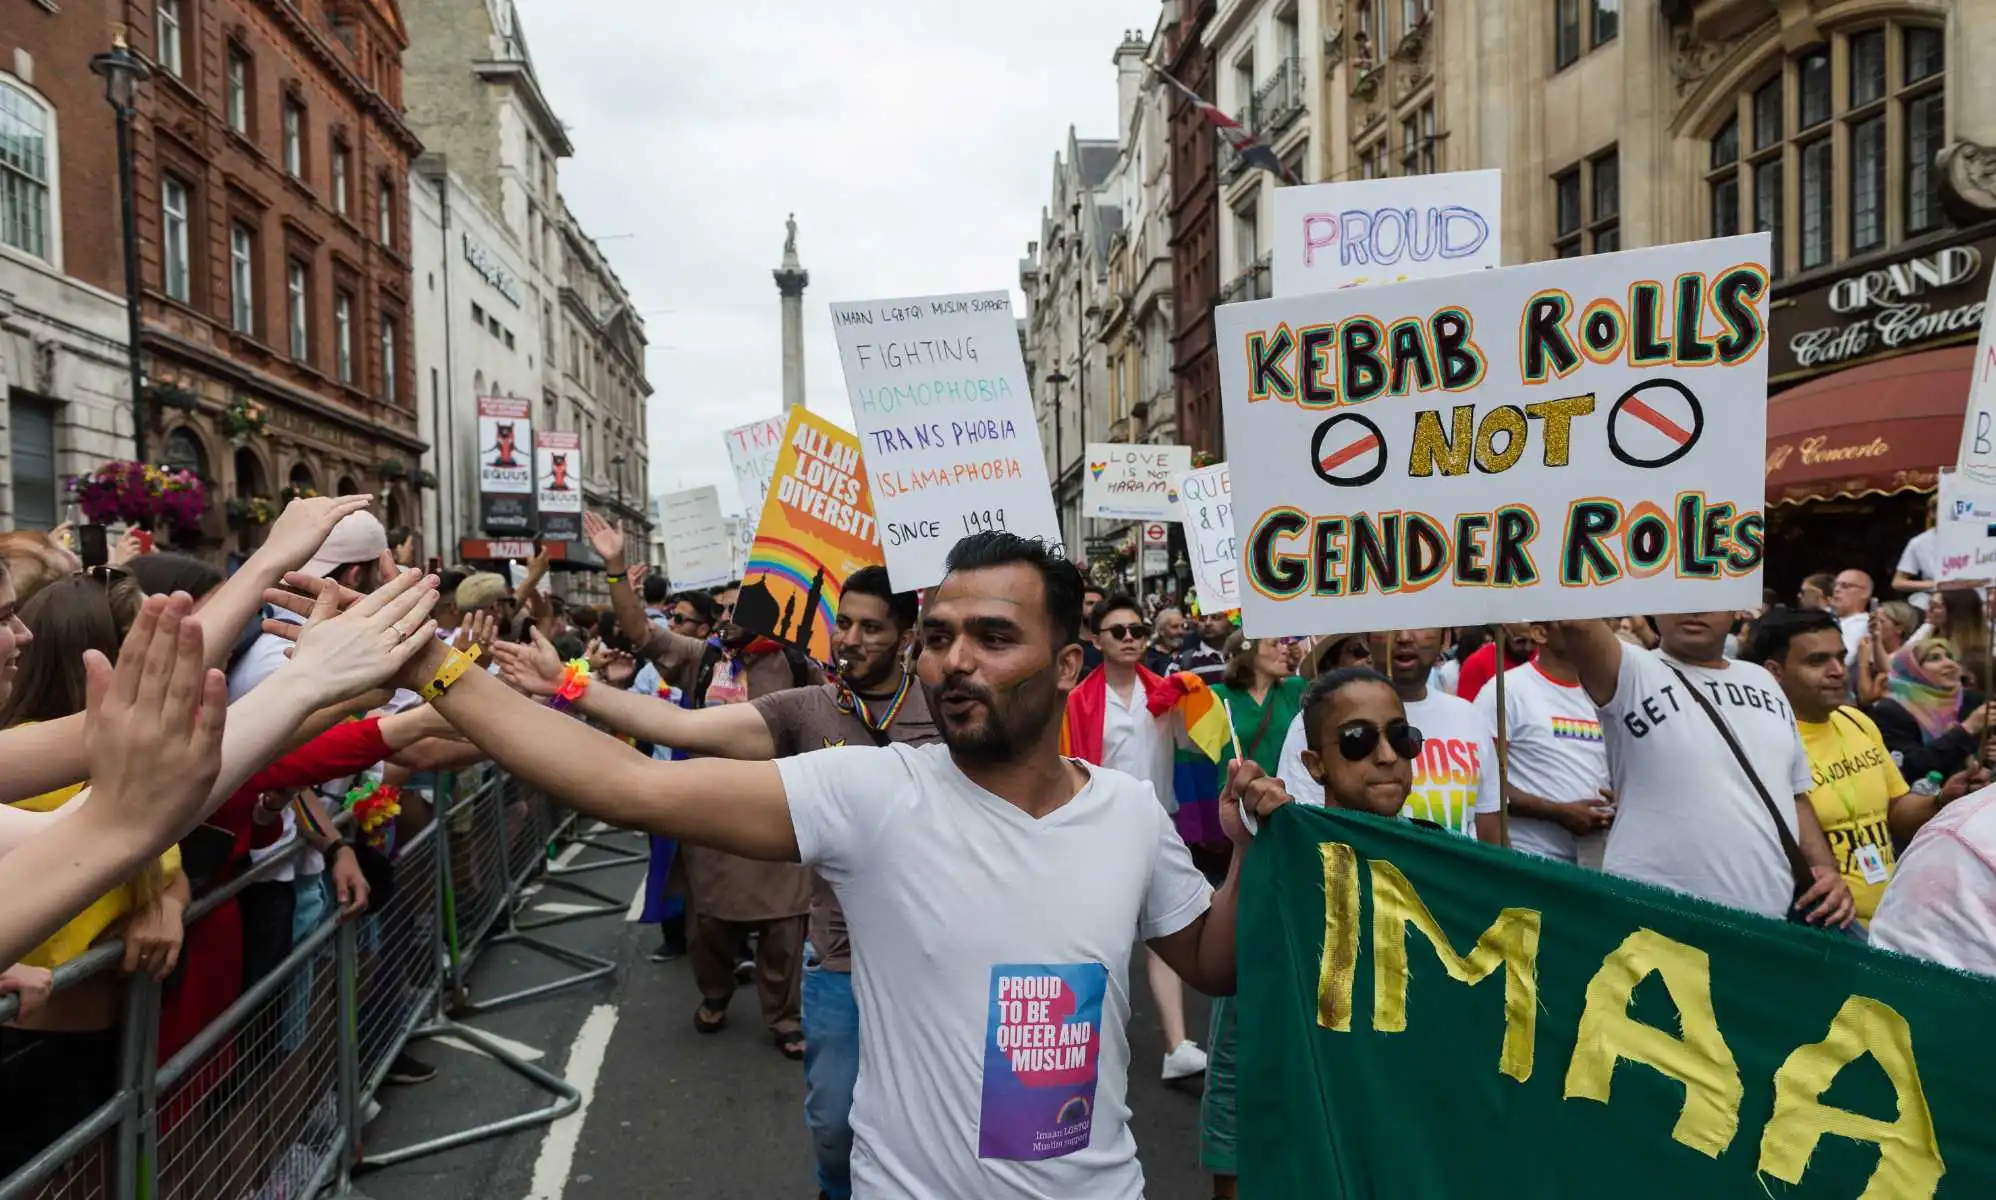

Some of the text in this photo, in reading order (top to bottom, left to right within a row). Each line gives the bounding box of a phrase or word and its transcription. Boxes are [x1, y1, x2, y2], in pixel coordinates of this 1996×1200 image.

[1303, 206, 1489, 267] PROUD
[1828, 246, 1979, 312] GRAND
[931, 301, 968, 316] MUSLIM
[972, 299, 1010, 313] SUPPORT
[856, 336, 979, 370] FIGHTING
[1246, 262, 1769, 411] KEBAB ROLLS
[857, 376, 1014, 413] HOMOPHOBIA
[791, 423, 861, 477] ALLAH
[1408, 392, 1596, 478] NOT
[1800, 434, 1890, 465] Concerto
[1109, 451, 1169, 468] LOVE
[1122, 467, 1170, 480] IS NOT
[794, 452, 862, 506] LOVES
[1106, 480, 1167, 494] HARAM
[887, 521, 940, 546] SINCE
[1244, 489, 1765, 602] GENDER ROLES
[1624, 685, 1680, 739] GET
[1704, 681, 1796, 738] TOGET
[998, 976, 1062, 1000] PROUD
[998, 1000, 1050, 1024] TO BE
[996, 1021, 1091, 1053] QUEER AND
[1011, 1046, 1086, 1072] MUSLIM
